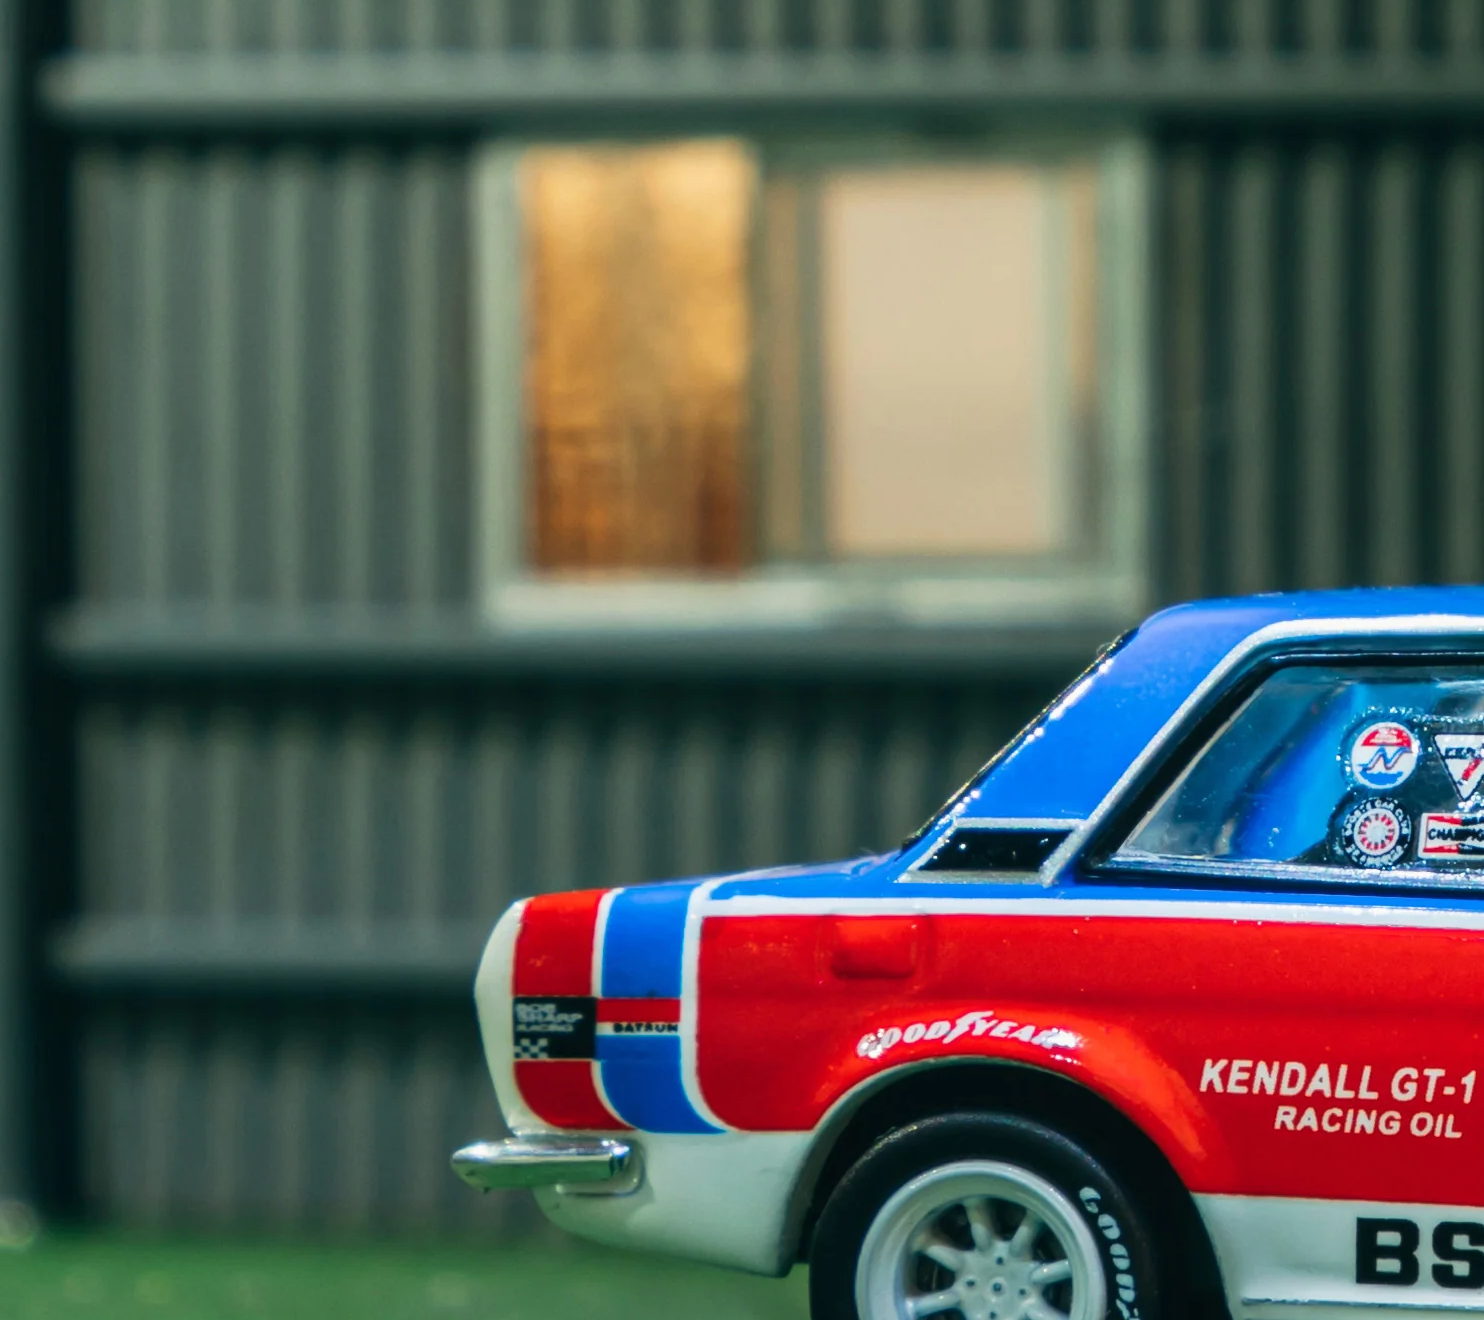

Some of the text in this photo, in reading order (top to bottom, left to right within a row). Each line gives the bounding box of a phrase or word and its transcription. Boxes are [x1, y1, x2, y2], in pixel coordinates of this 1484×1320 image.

[1199, 1058, 1477, 1104] KENDALL GT-1
[1274, 1105, 1463, 1139] RACING OIL
